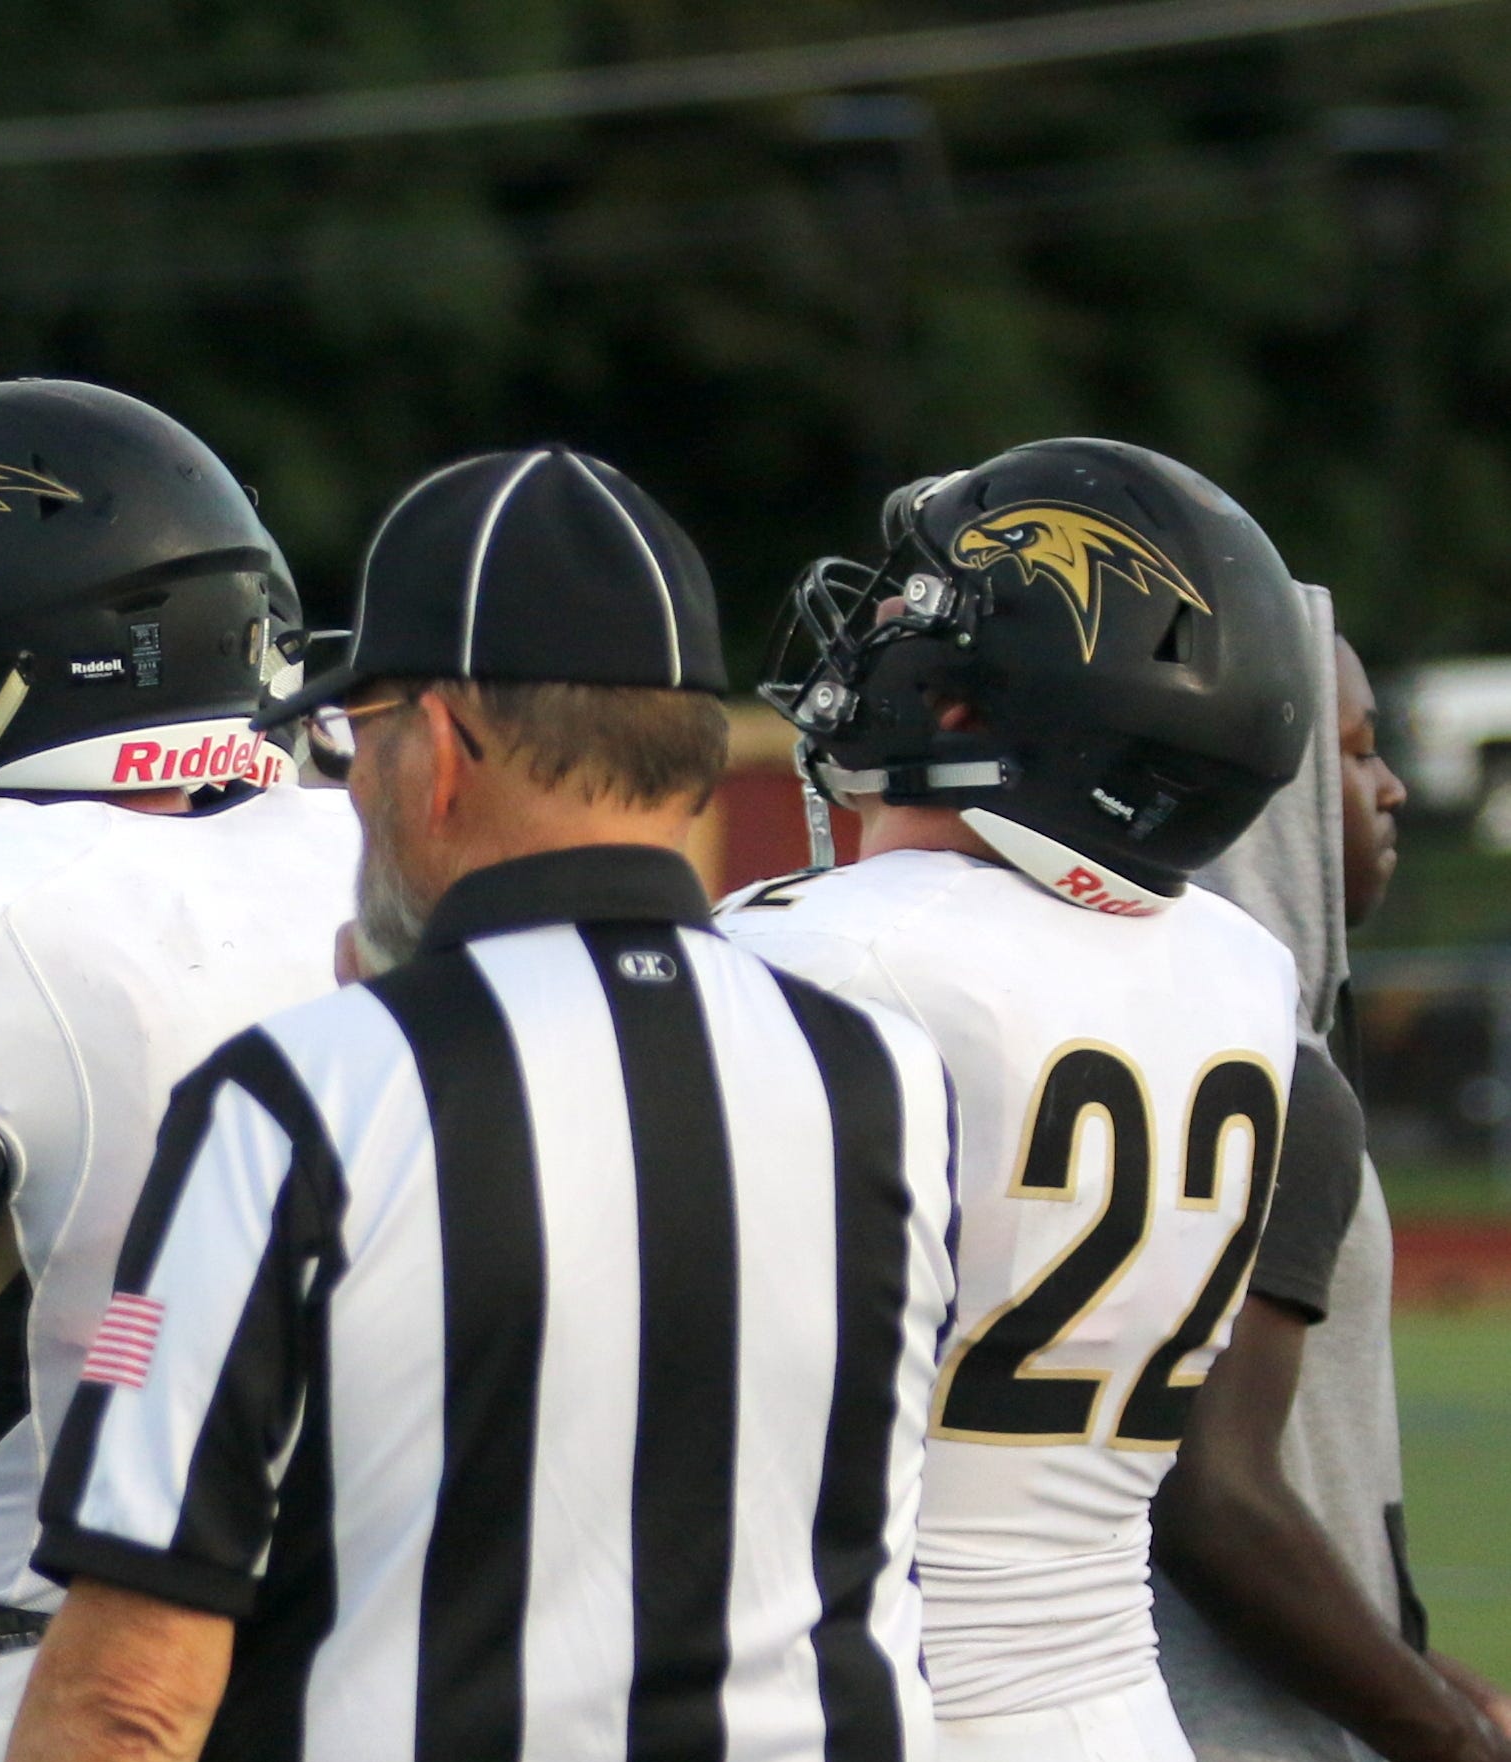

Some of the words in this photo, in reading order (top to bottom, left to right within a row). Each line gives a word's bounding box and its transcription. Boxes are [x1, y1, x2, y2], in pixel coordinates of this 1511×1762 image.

[71, 659, 122, 674] Riddell
[112, 730, 266, 783] Riddel
[928, 1037, 1287, 1453] 22
